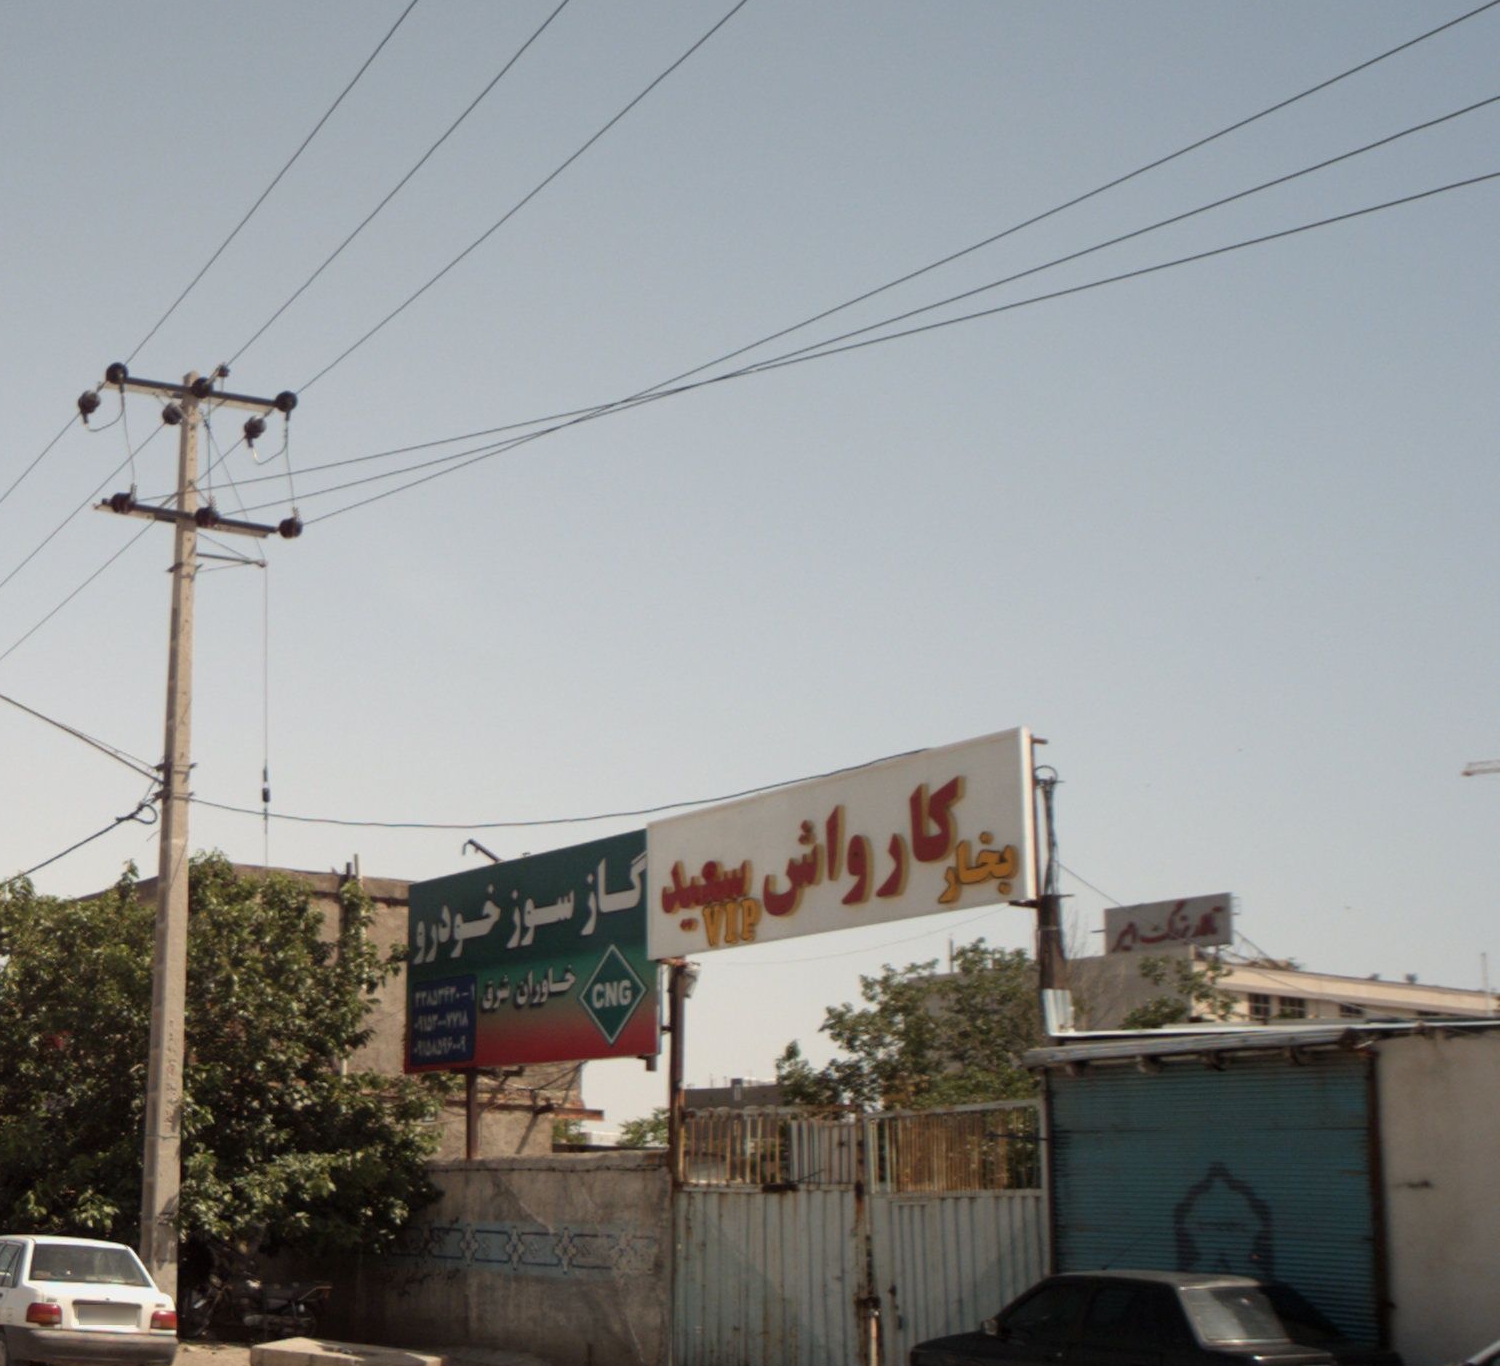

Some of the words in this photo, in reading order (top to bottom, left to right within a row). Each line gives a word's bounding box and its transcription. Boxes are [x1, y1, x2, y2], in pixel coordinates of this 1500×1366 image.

[937, 831, 1019, 904] بخار
[662, 860, 752, 932] سعید
[411, 883, 500, 965] خودرو
[702, 897, 761, 947] VIP
[482, 975, 510, 1009] شرق
[516, 965, 577, 1005] خاوران
[592, 979, 632, 1009] CNG
